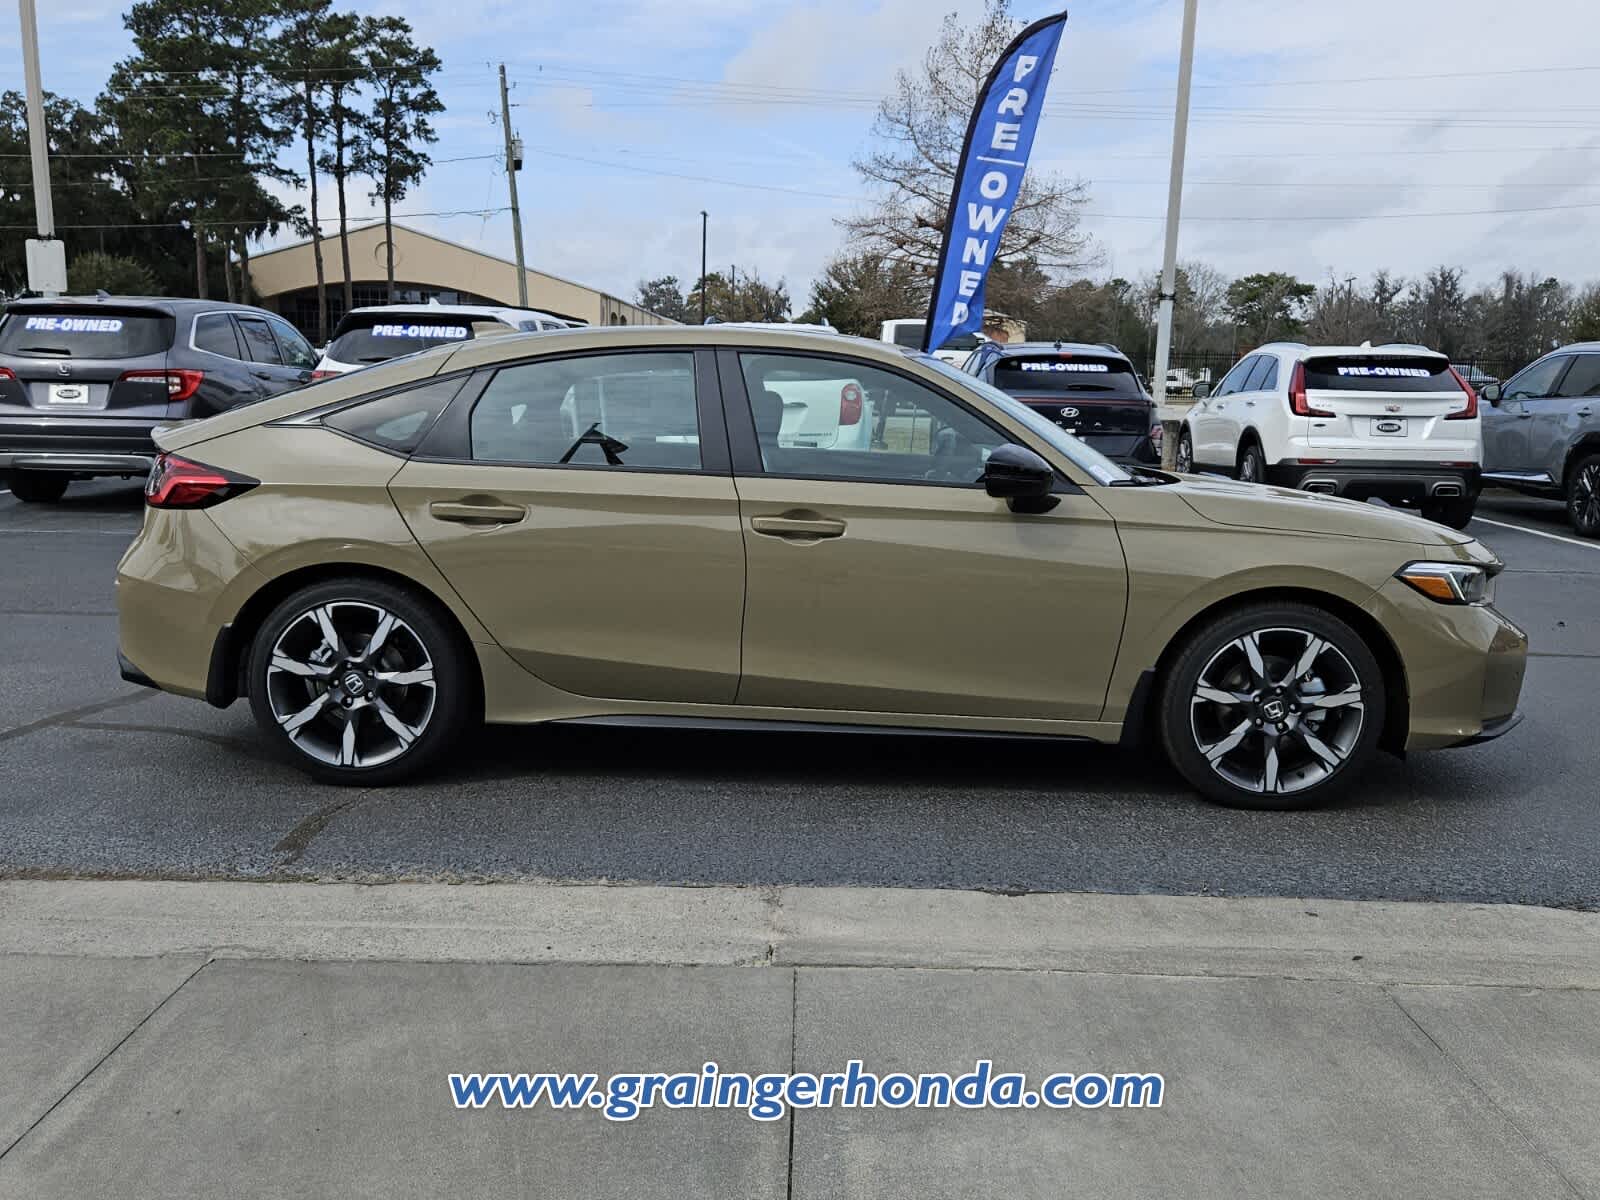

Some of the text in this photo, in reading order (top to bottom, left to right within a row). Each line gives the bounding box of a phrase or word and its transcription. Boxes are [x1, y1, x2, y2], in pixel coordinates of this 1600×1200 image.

[25, 317, 122, 332] PRE-OWNED
[371, 325, 467, 338] PRE-OWNED
[1021, 362, 1109, 372] PRE-OWNED
[1337, 367, 1431, 378] PRE-OWNED
